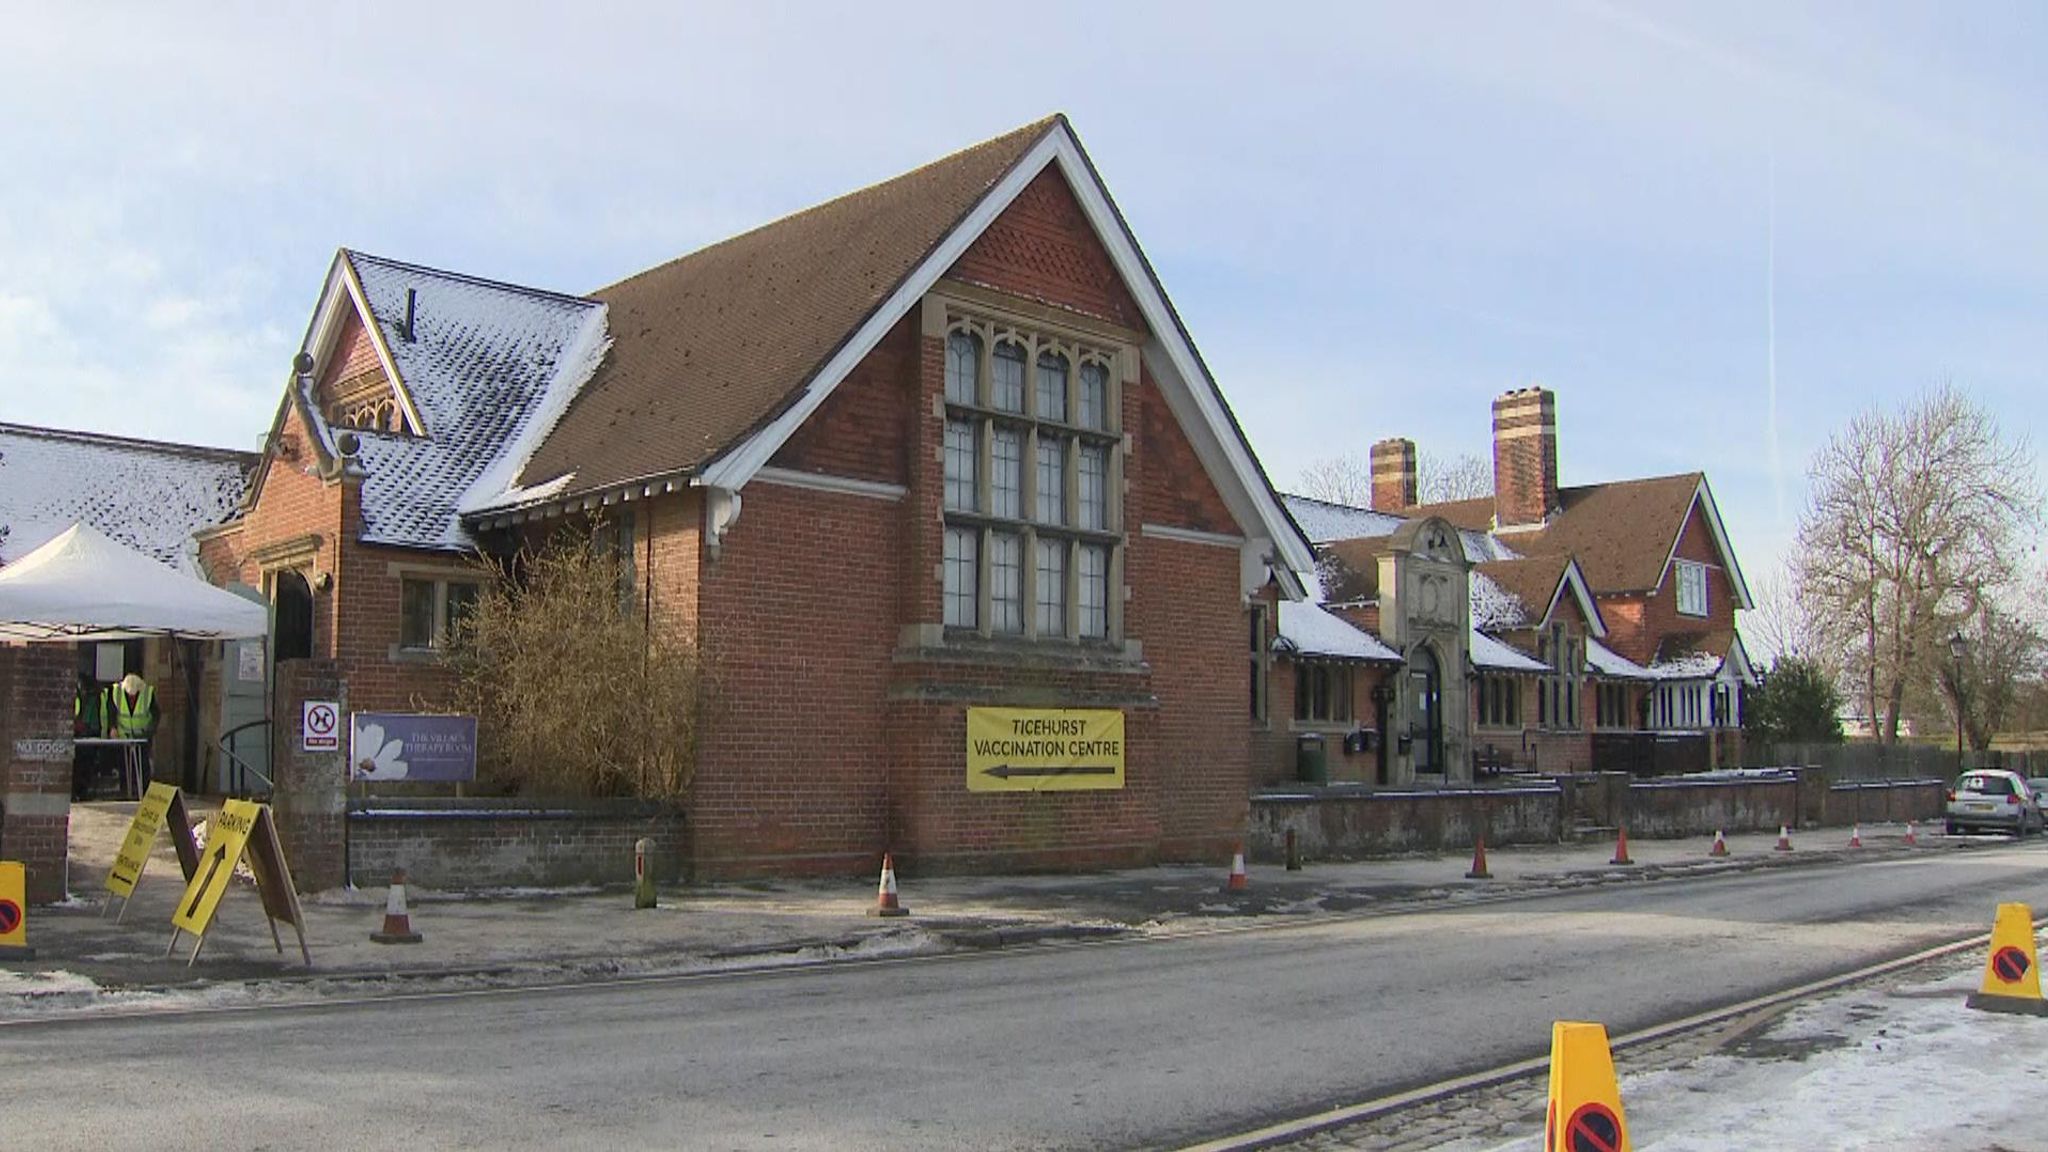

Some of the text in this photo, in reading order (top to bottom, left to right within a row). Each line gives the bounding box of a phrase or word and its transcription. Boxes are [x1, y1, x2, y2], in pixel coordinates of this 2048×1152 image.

[1012, 719, 1086, 736] TICEHURST
[16, 743, 66, 753] NO DOGS
[974, 740, 1119, 757] VACCINATION CENTRE
[217, 811, 250, 835] PARKING
